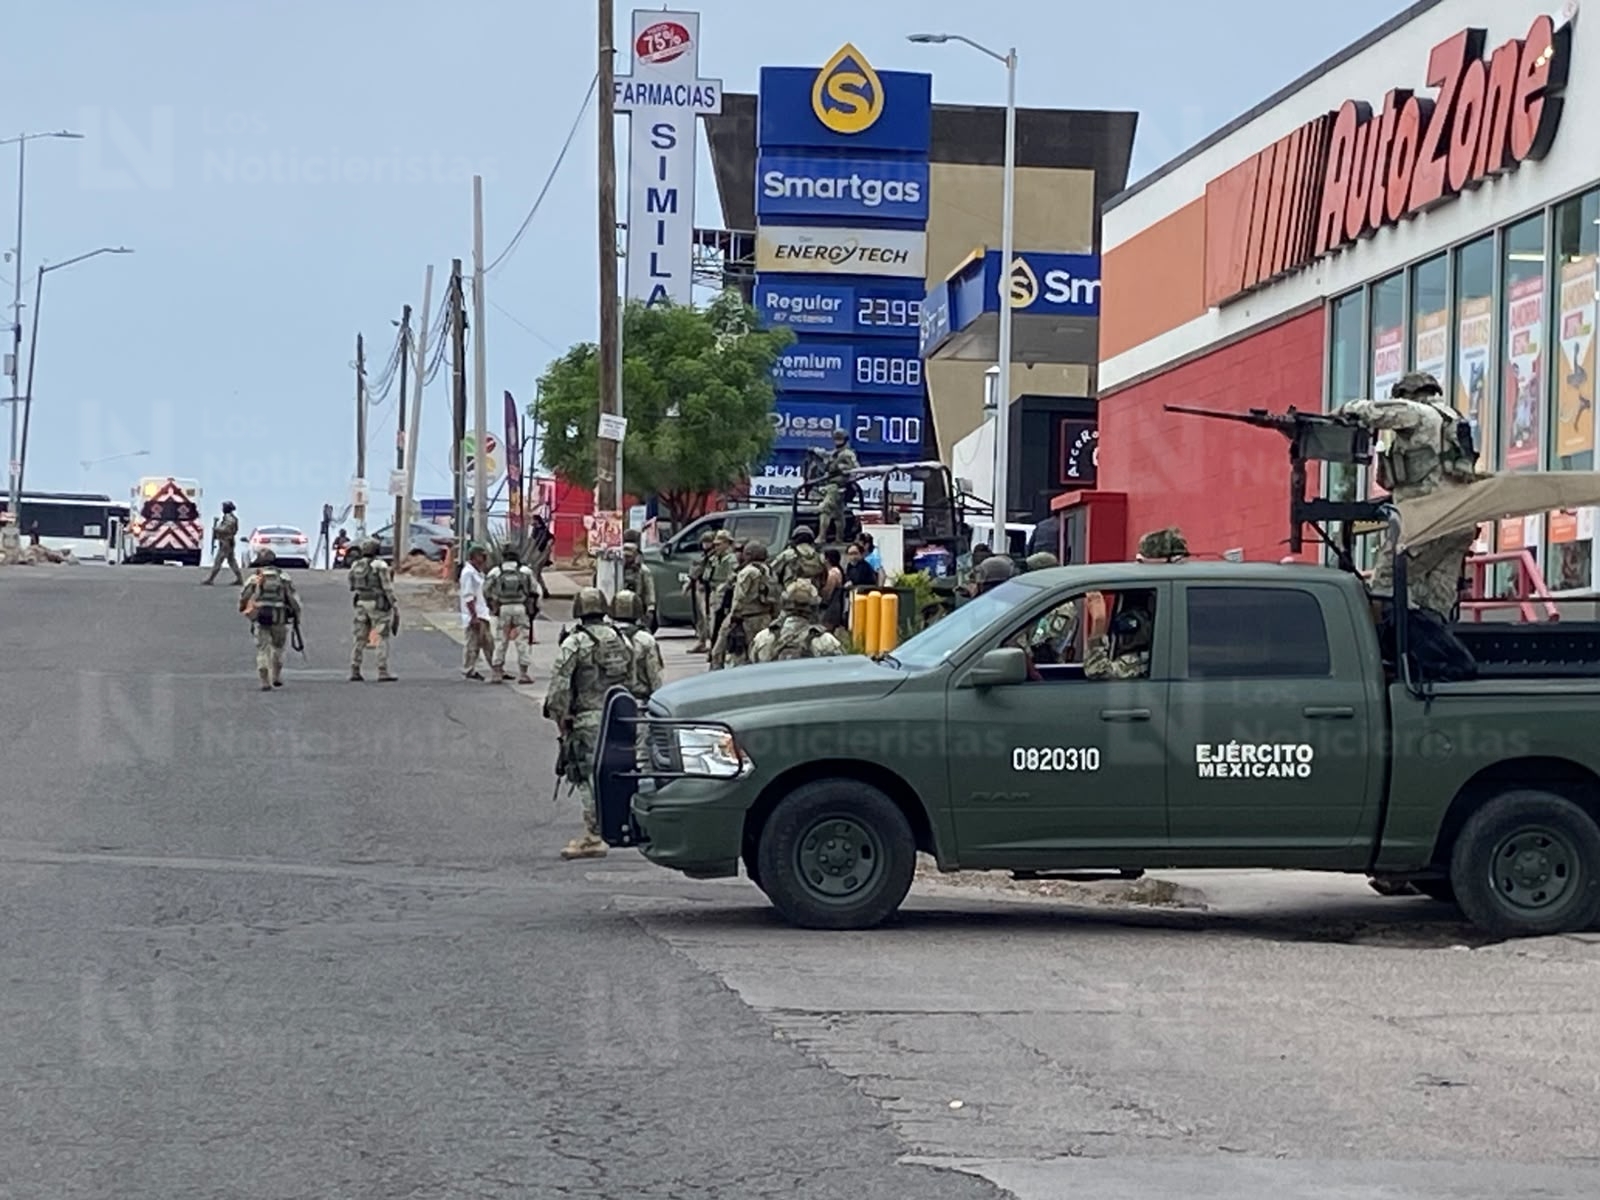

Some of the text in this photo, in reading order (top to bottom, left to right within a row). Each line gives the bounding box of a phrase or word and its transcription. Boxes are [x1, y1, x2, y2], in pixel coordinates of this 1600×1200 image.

[643, 26, 682, 54] 75%
[613, 82, 716, 108] FARMACIAS
[1314, 15, 1556, 258] AutoZone
[763, 171, 921, 206] Smartgas
[774, 241, 909, 265] ENERGYTECH
[1044, 269, 1101, 304] Sm
[766, 292, 843, 312] Regular
[776, 353, 842, 370] remium
[766, 411, 842, 430] Diesel
[1012, 747, 1100, 771] 0820310
[1195, 740, 1314, 763] EJÉRCITO
[1198, 763, 1312, 778] MEXICANO
